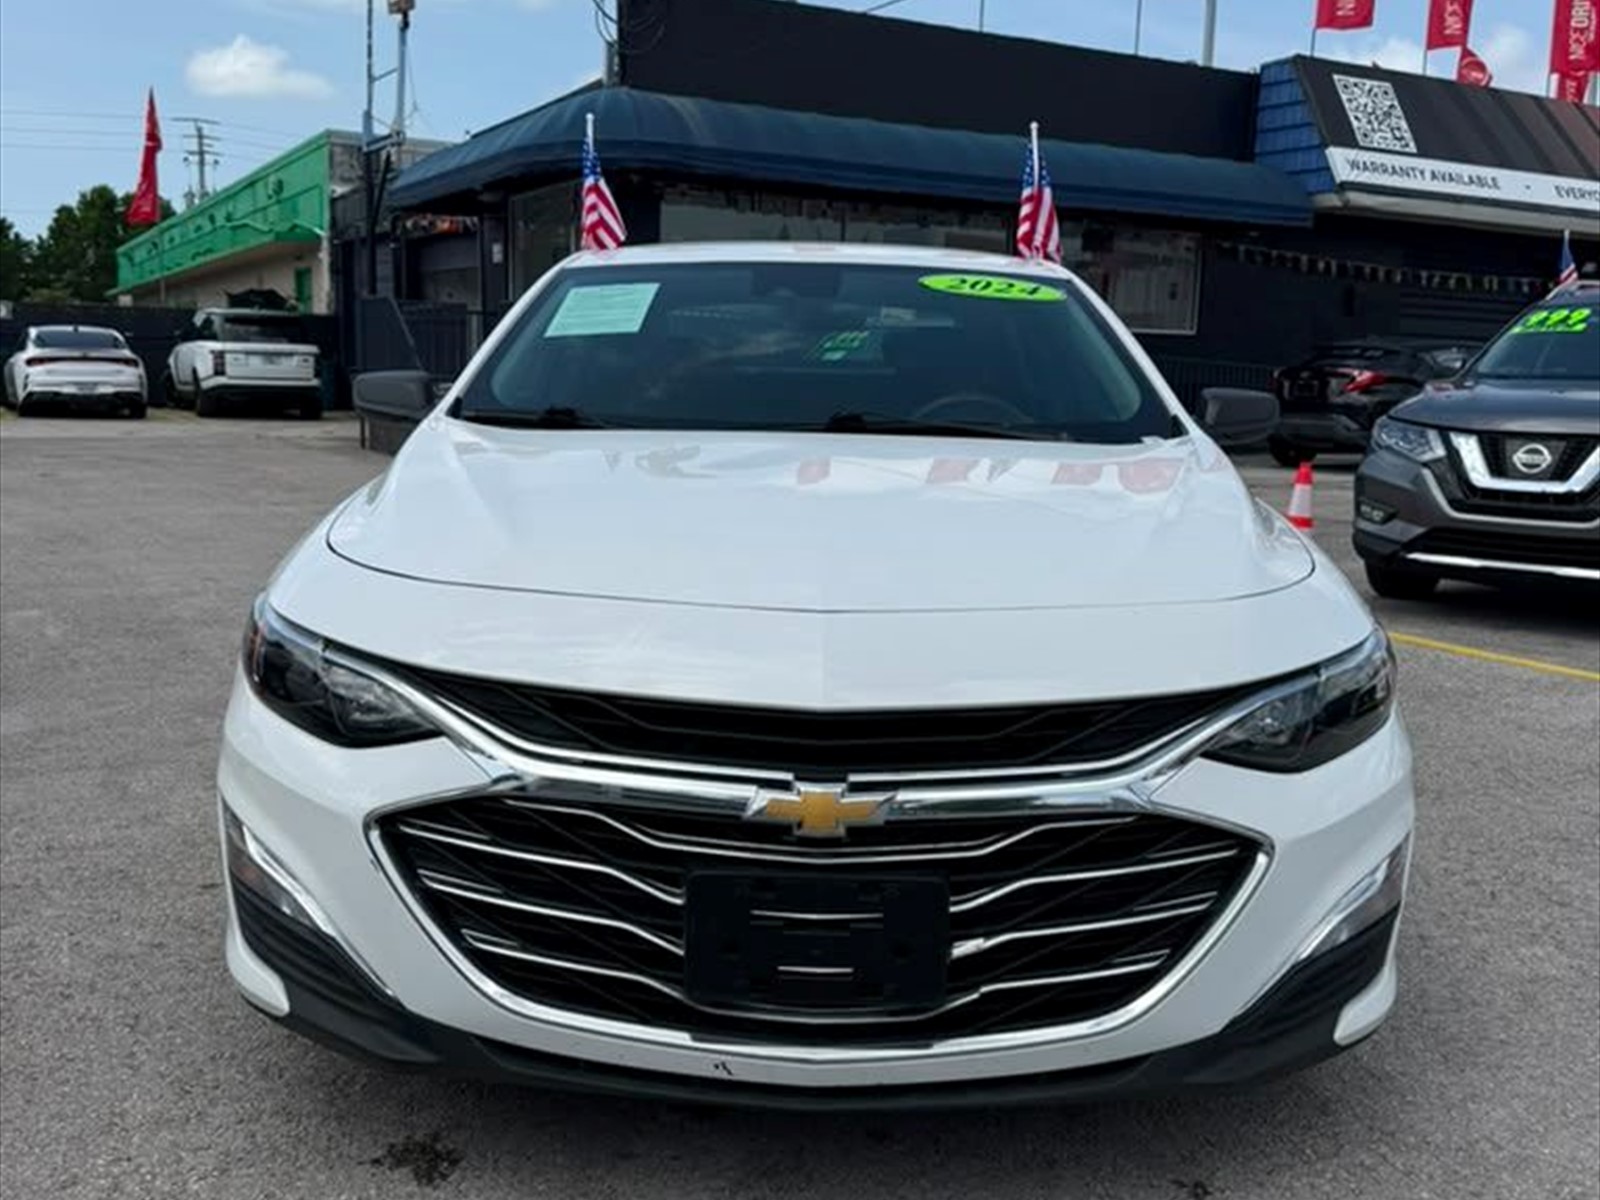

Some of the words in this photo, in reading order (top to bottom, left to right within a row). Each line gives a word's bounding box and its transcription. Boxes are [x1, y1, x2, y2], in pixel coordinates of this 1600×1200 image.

[1347, 158, 1426, 181] WARRANTY
[1430, 169, 1500, 190] AVAILABLE
[945, 278, 1041, 296] 2024
